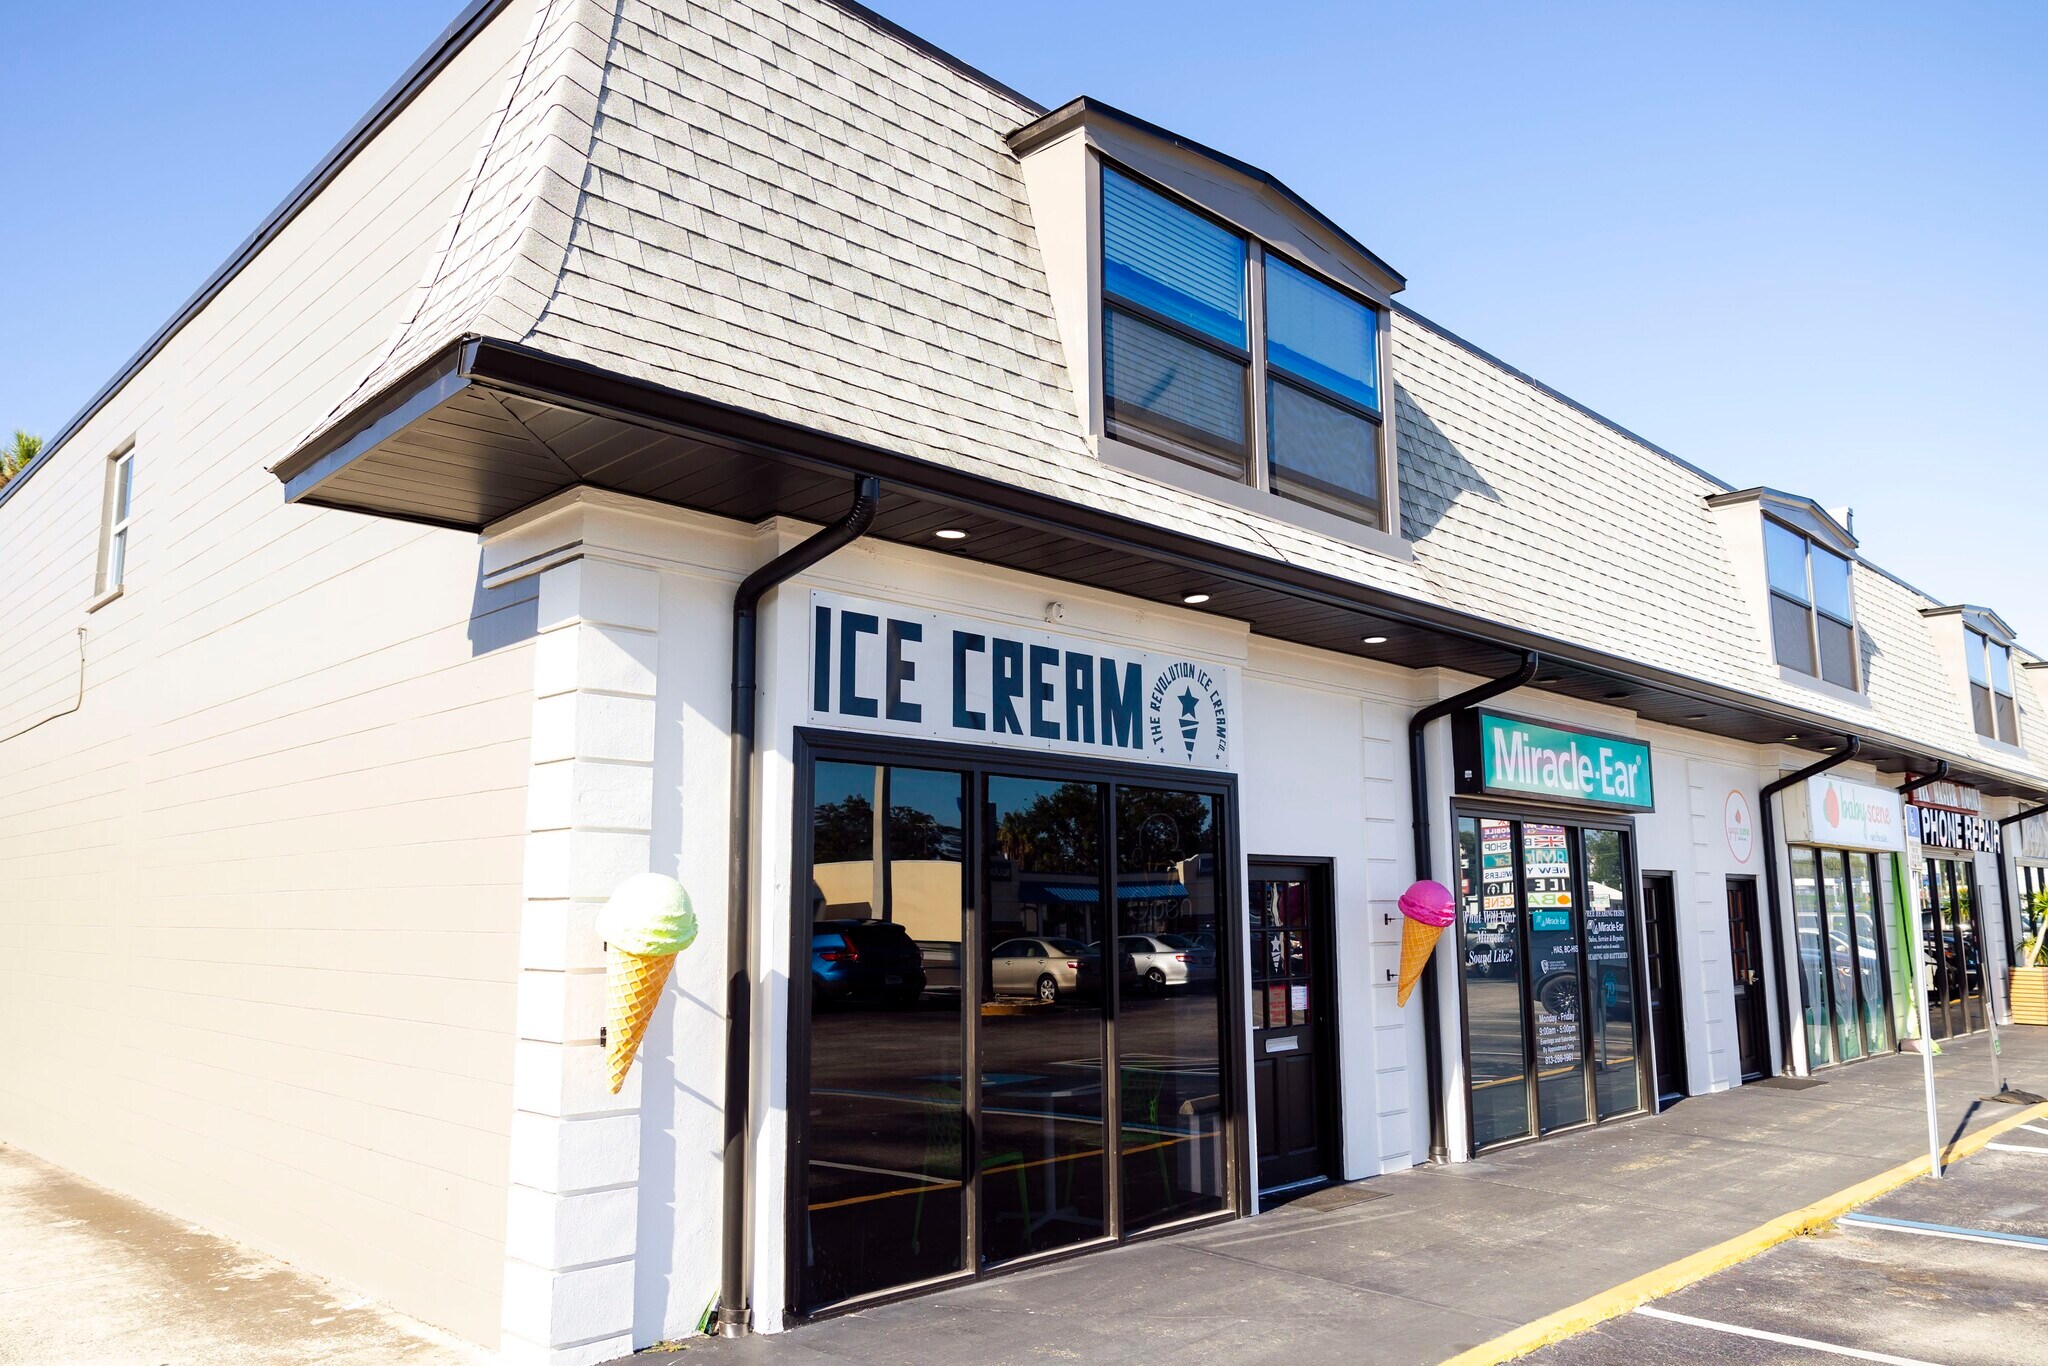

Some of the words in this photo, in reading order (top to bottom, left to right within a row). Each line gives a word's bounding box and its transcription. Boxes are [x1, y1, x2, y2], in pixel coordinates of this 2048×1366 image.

[814, 605, 922, 723] ICE
[952, 630, 1144, 750] CREAM
[1150, 663, 1195, 712] REVOLUTION
[1197, 669, 1213, 692] ICE
[1150, 716, 1163, 745] THE
[1210, 690, 1226, 738] CREAM
[1493, 727, 1638, 799] Miracle-Ear
[1840, 786, 1867, 840] baby
[1867, 804, 1891, 825] scene
[1921, 807, 1963, 848] PHONE
[1964, 815, 2000, 854] REPAIR
[1469, 950, 1492, 963] Sound
[1493, 949, 1514, 962] Like?
